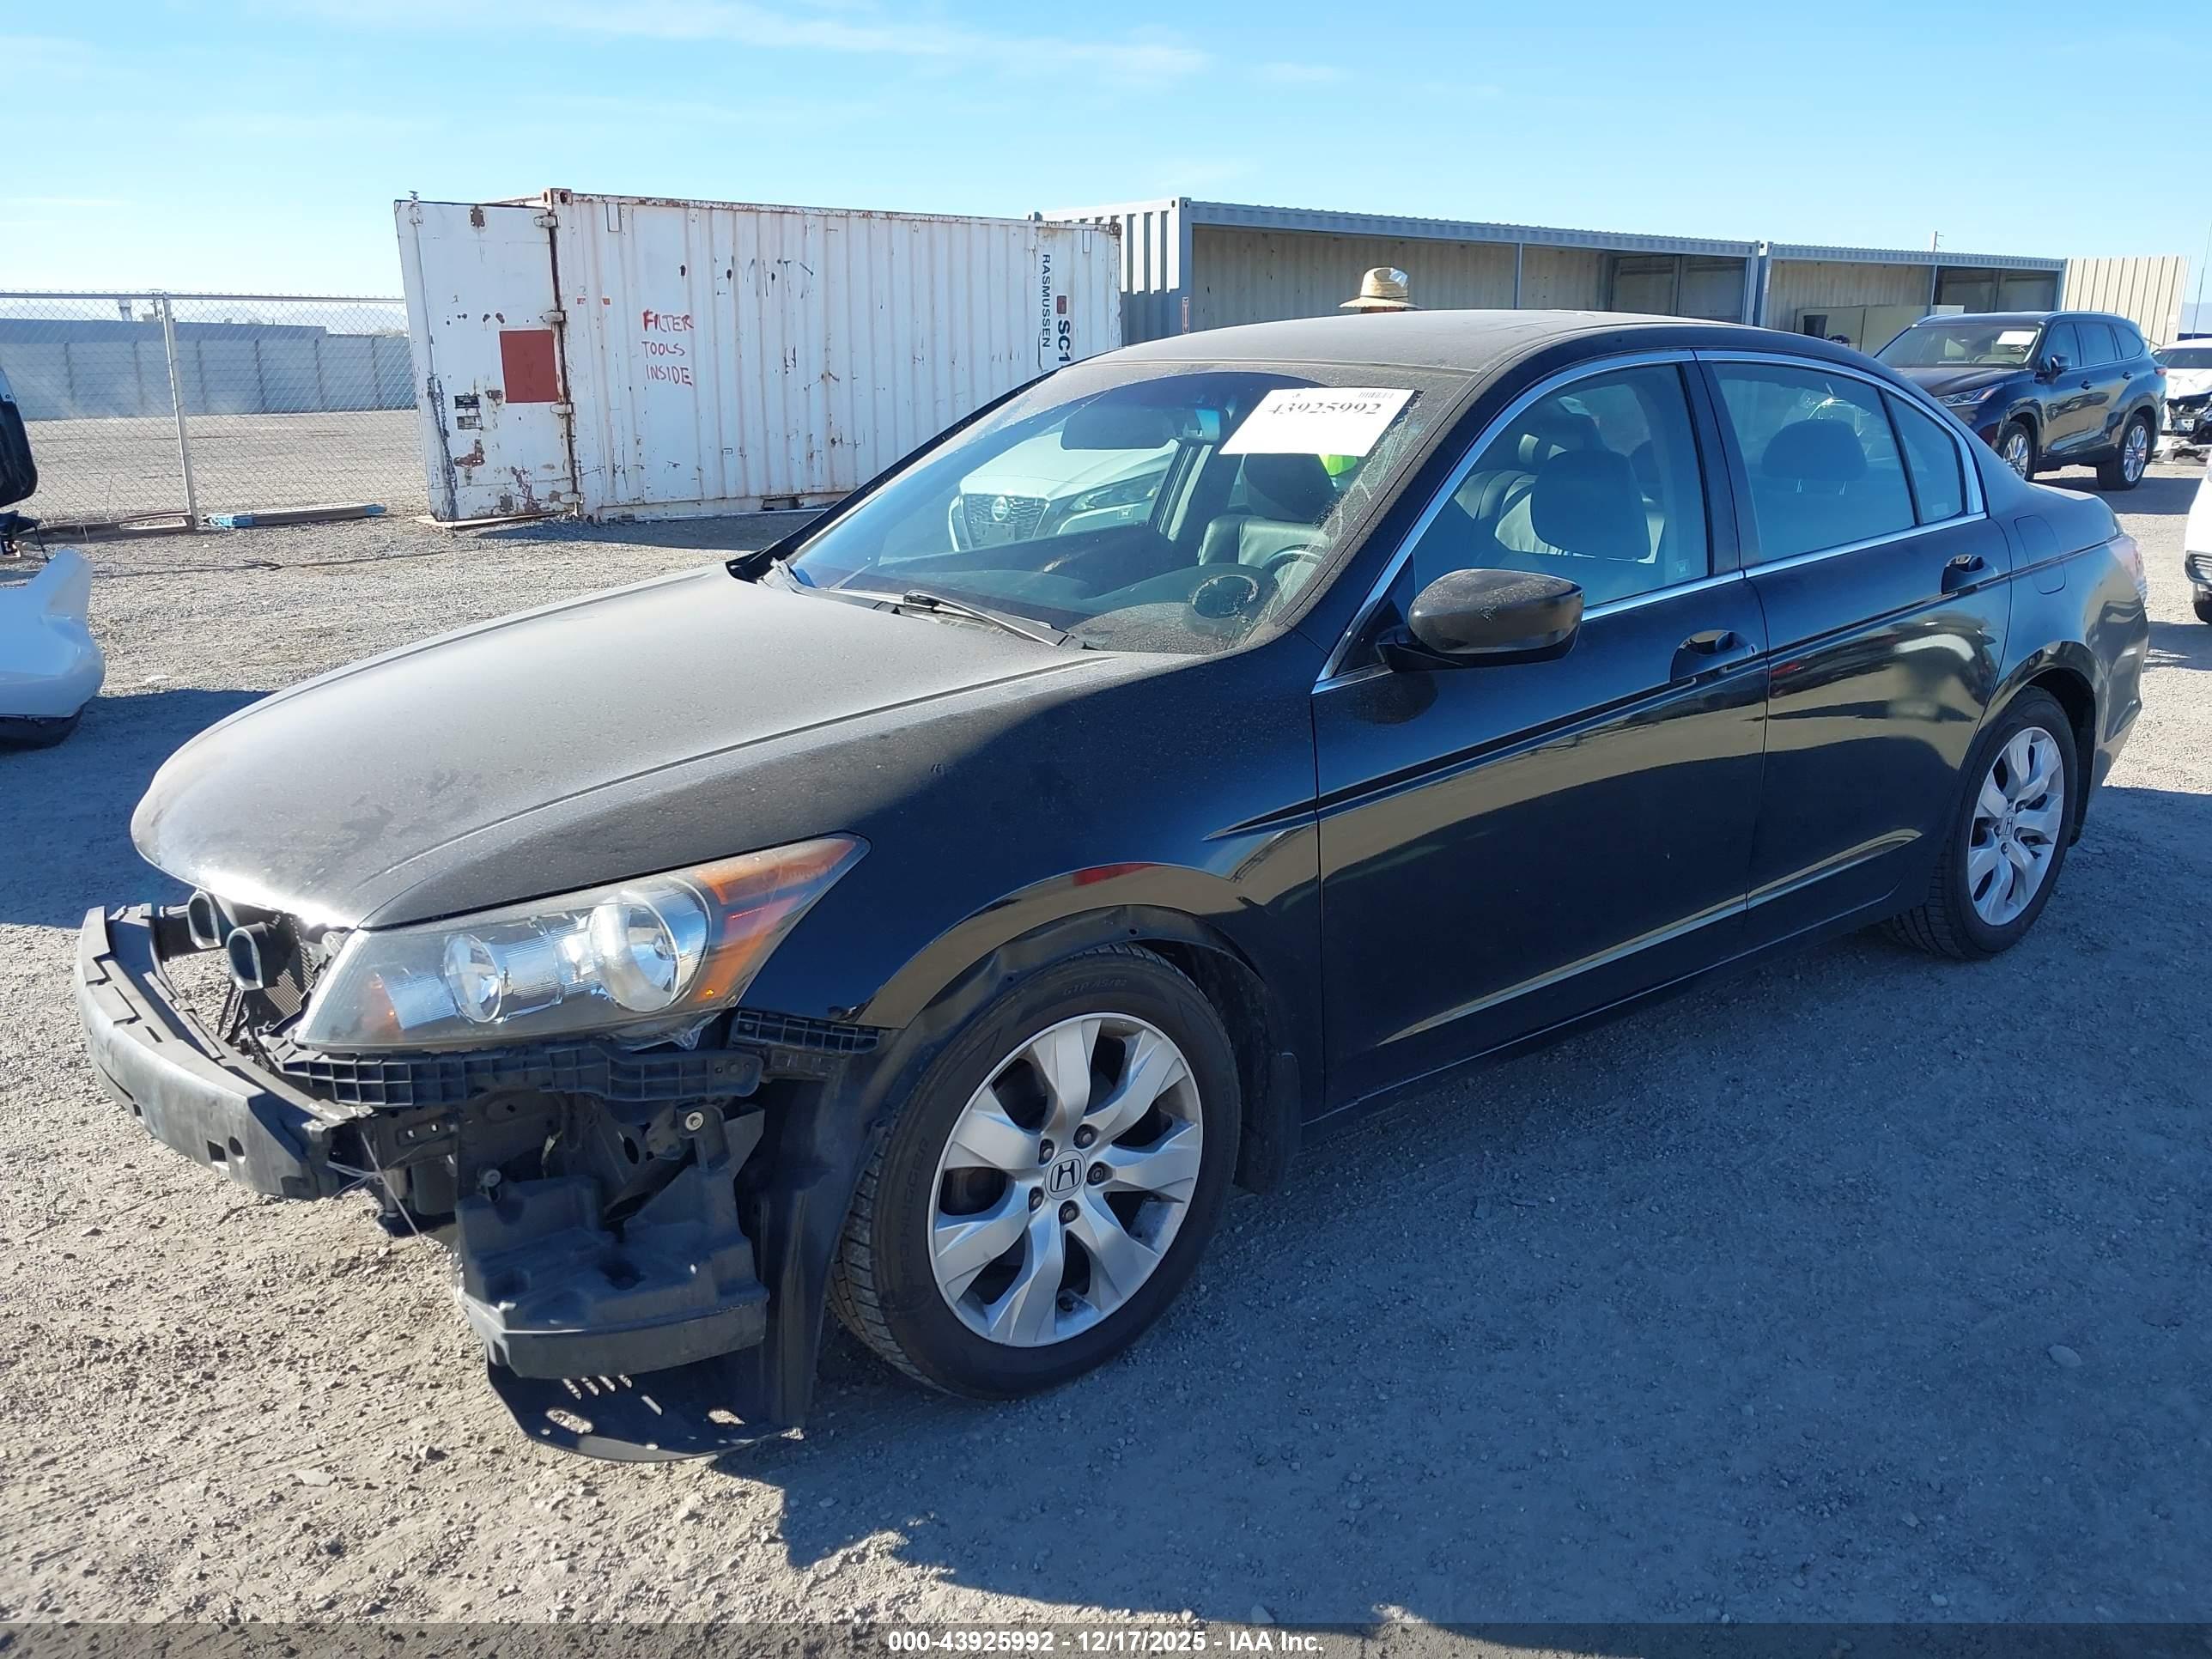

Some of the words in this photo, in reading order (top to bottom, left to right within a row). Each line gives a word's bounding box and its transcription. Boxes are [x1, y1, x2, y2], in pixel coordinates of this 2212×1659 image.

[1042, 254, 1051, 348] RASMUSSEN
[642, 309, 695, 333] FILTER
[641, 341, 685, 359] TOOLS
[646, 363, 693, 386] INSIDE
